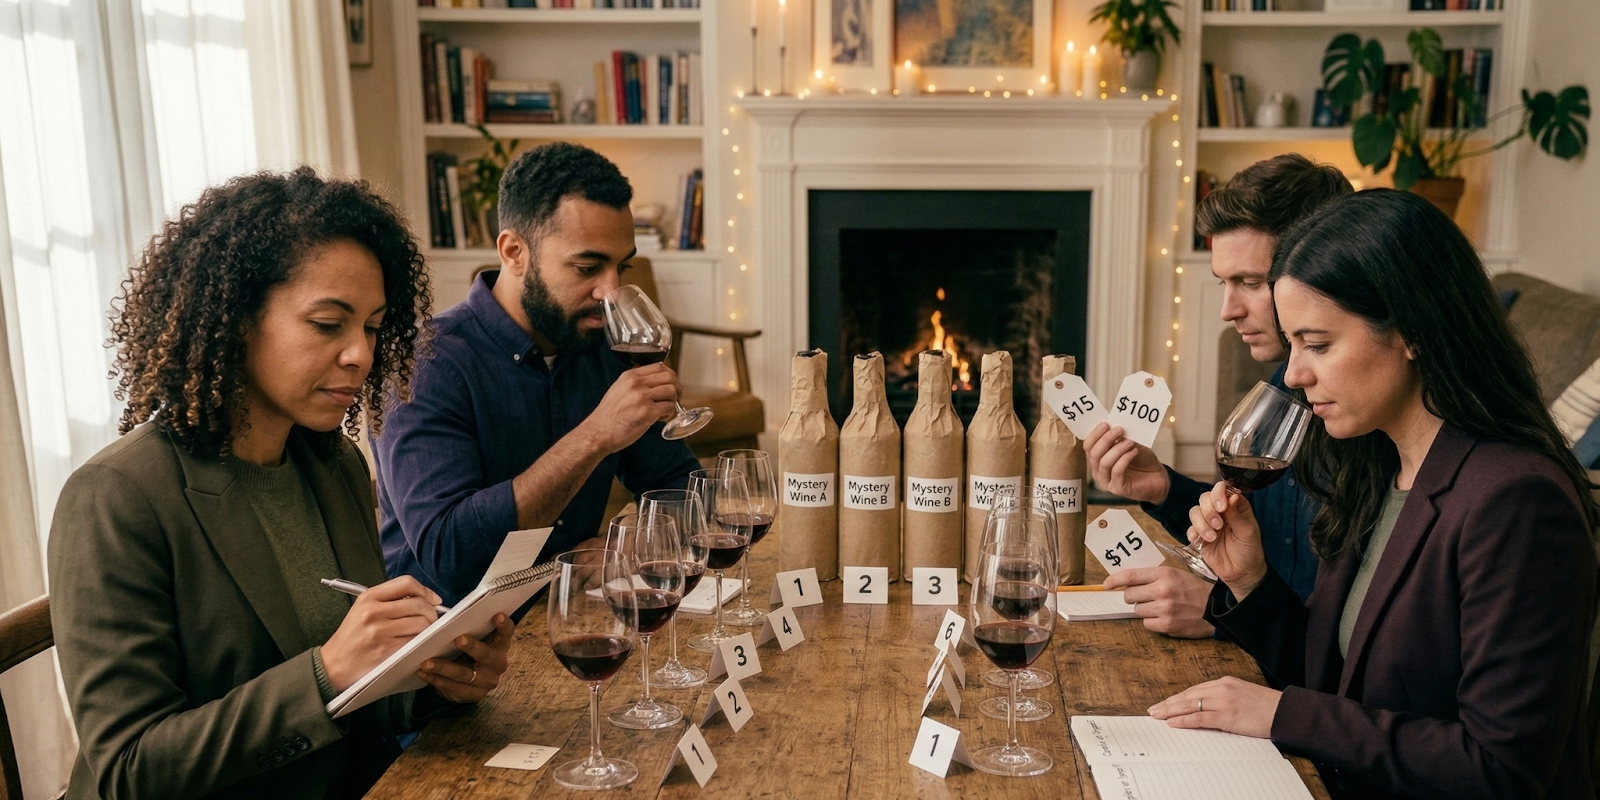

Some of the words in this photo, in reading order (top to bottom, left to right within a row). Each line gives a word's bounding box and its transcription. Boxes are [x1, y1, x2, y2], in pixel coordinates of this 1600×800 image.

[1062, 395, 1095, 421] $15
[1116, 395, 1160, 424] $100
[787, 478, 829, 493] Mystery
[848, 481, 890, 494] Mystery
[911, 482, 953, 496] Mystery
[790, 491, 816, 503] Wine
[819, 492, 827, 502] A
[850, 493, 878, 505] Wine
[880, 494, 888, 505] B
[914, 495, 941, 507] Wine
[944, 496, 951, 507] B
[1068, 498, 1076, 508] H
[1105, 530, 1144, 567] $15
[793, 577, 804, 597] 1
[858, 574, 872, 594] 2
[928, 575, 942, 595] 3
[782, 616, 793, 635] 4
[945, 621, 956, 641] 6
[733, 645, 747, 667] 3
[727, 691, 742, 714] 2
[690, 742, 705, 766] 1
[929, 733, 940, 757] 1
